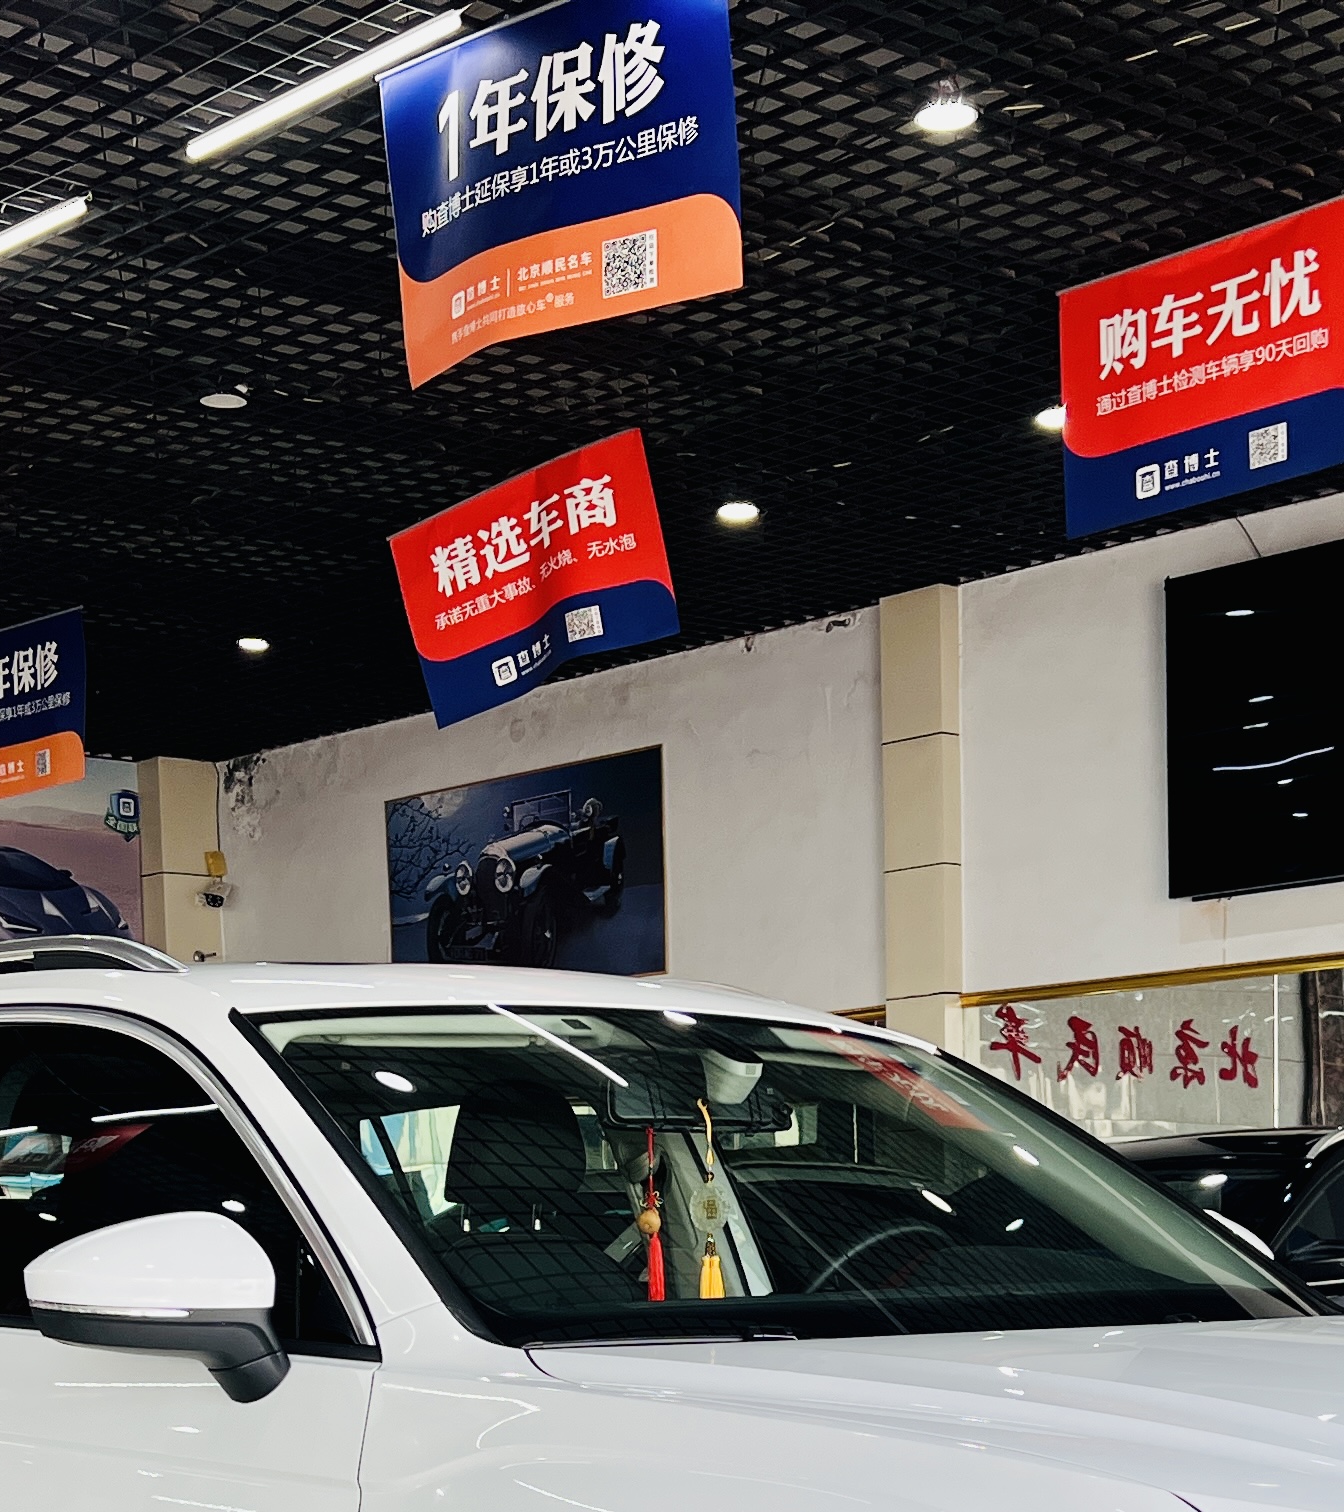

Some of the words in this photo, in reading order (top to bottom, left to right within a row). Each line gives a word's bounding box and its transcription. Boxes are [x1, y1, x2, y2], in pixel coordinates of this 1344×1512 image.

[437, 20, 666, 181] 1年保修
[422, 115, 699, 238] 购查博士延保享1年或3万公里保修
[517, 251, 593, 282] 北京顺民名车
[1099, 248, 1322, 380] 购车无忧
[1096, 328, 1329, 416] 通过查博士检测车辆享90天回购
[1164, 448, 1220, 480] 查博士
[430, 474, 617, 598] 精选车商
[587, 533, 637, 560] 无水泡
